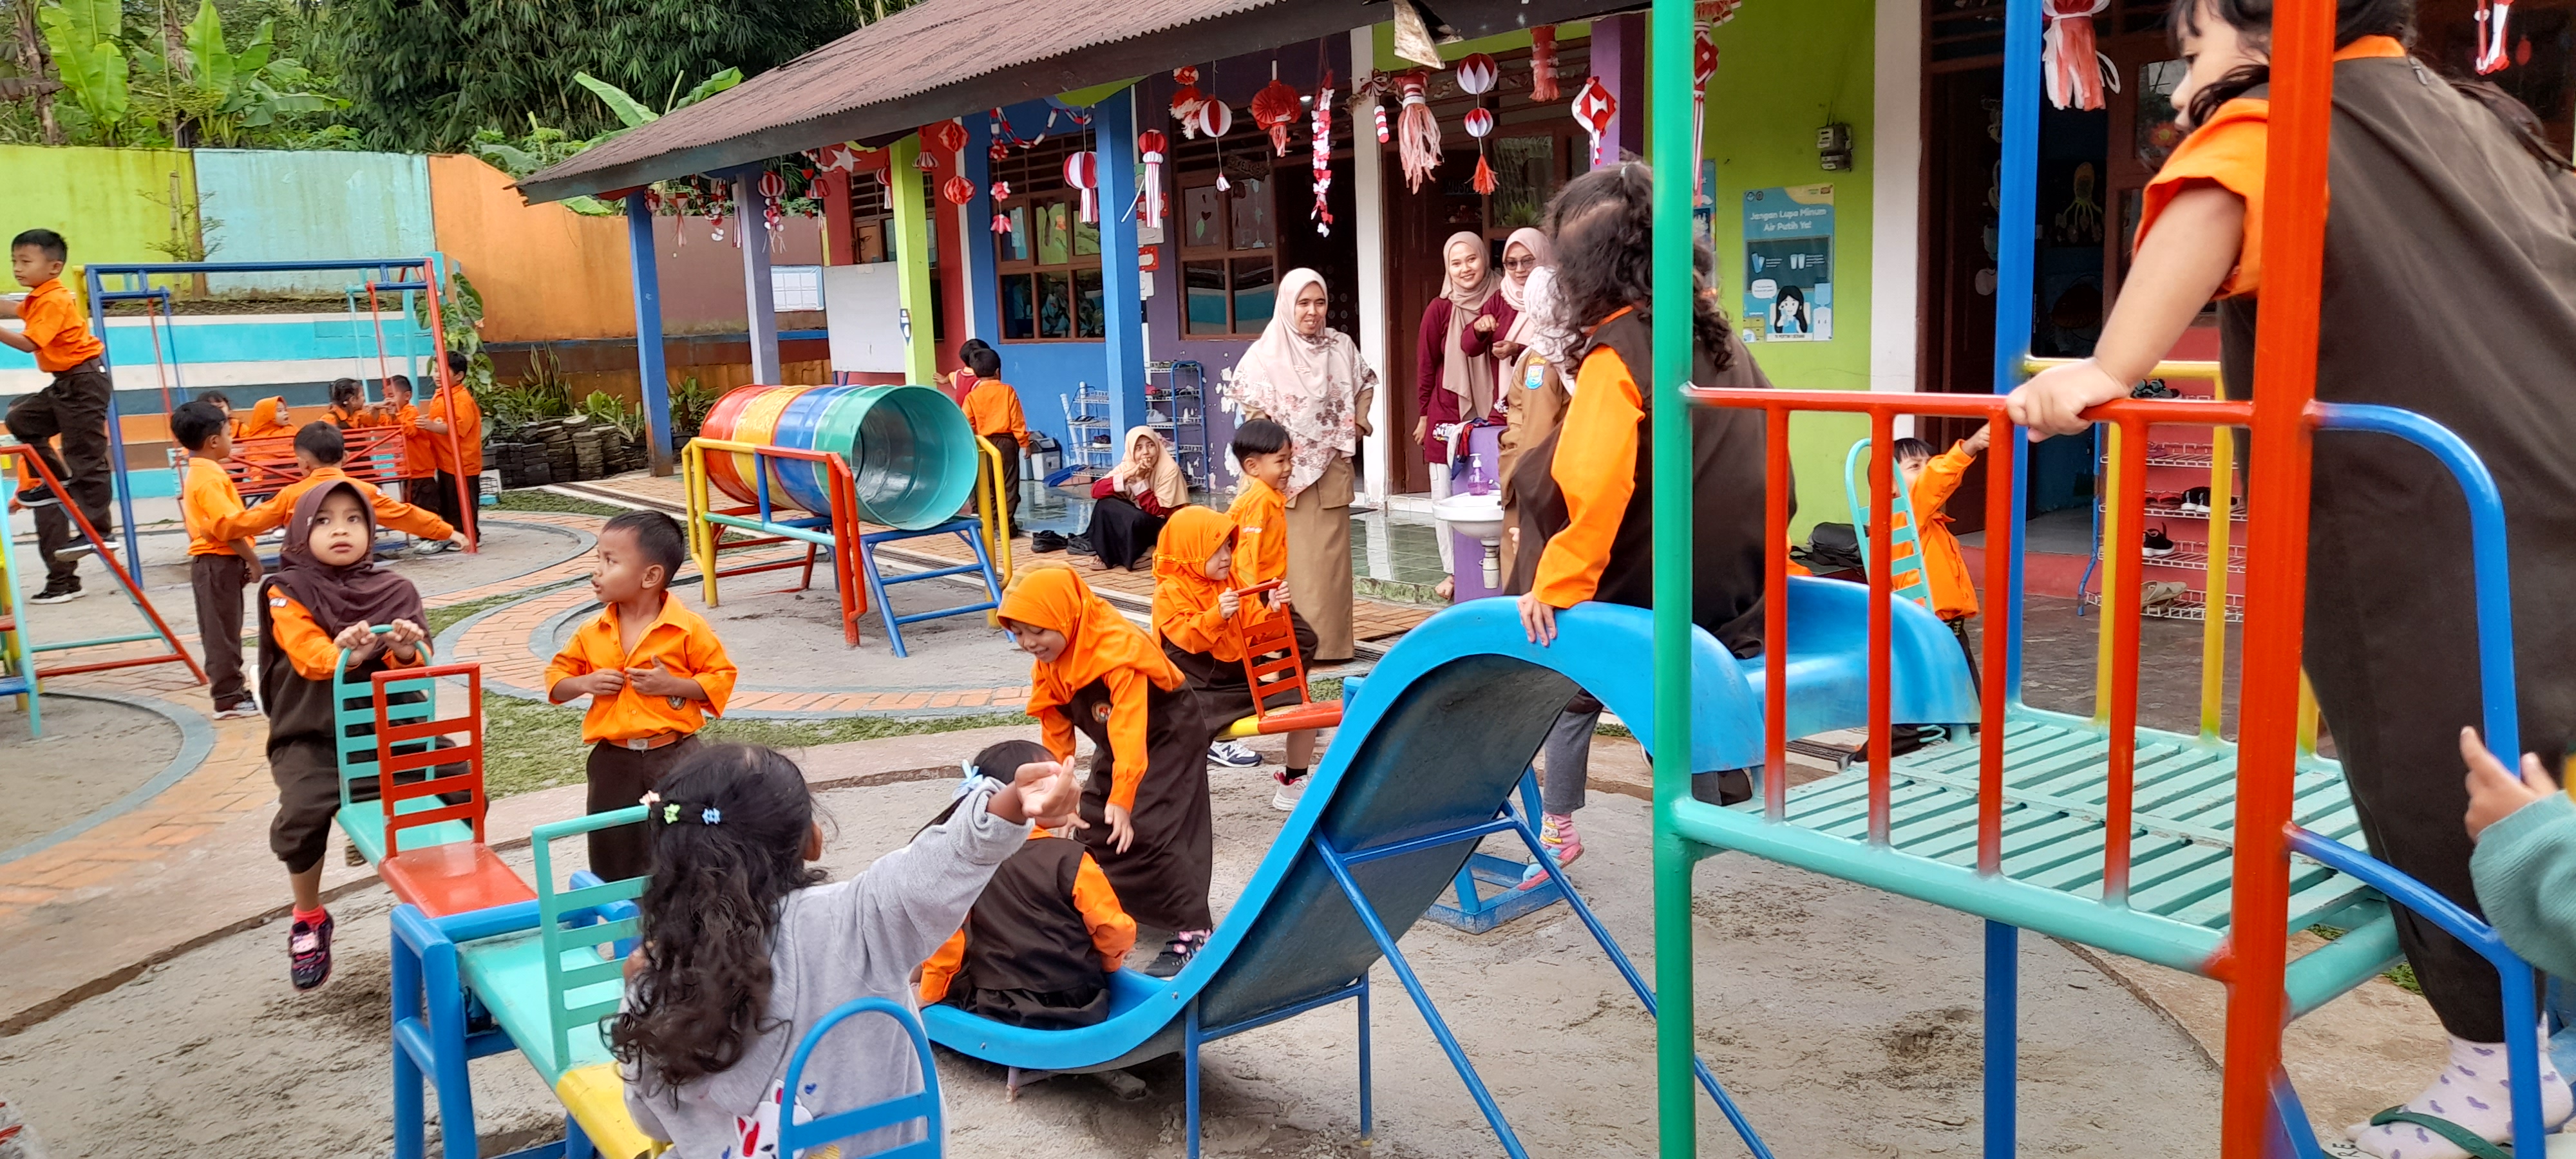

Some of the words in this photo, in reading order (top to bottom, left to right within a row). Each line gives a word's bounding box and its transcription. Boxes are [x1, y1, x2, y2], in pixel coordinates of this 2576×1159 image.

[1750, 212, 1777, 221] Jangan
[1779, 210, 1799, 220] Lupa
[1799, 207, 1826, 216] Minum
[1763, 222, 1776, 231] Air
[1777, 221, 1798, 231] Putih
[1799, 220, 1812, 229] Ya!
